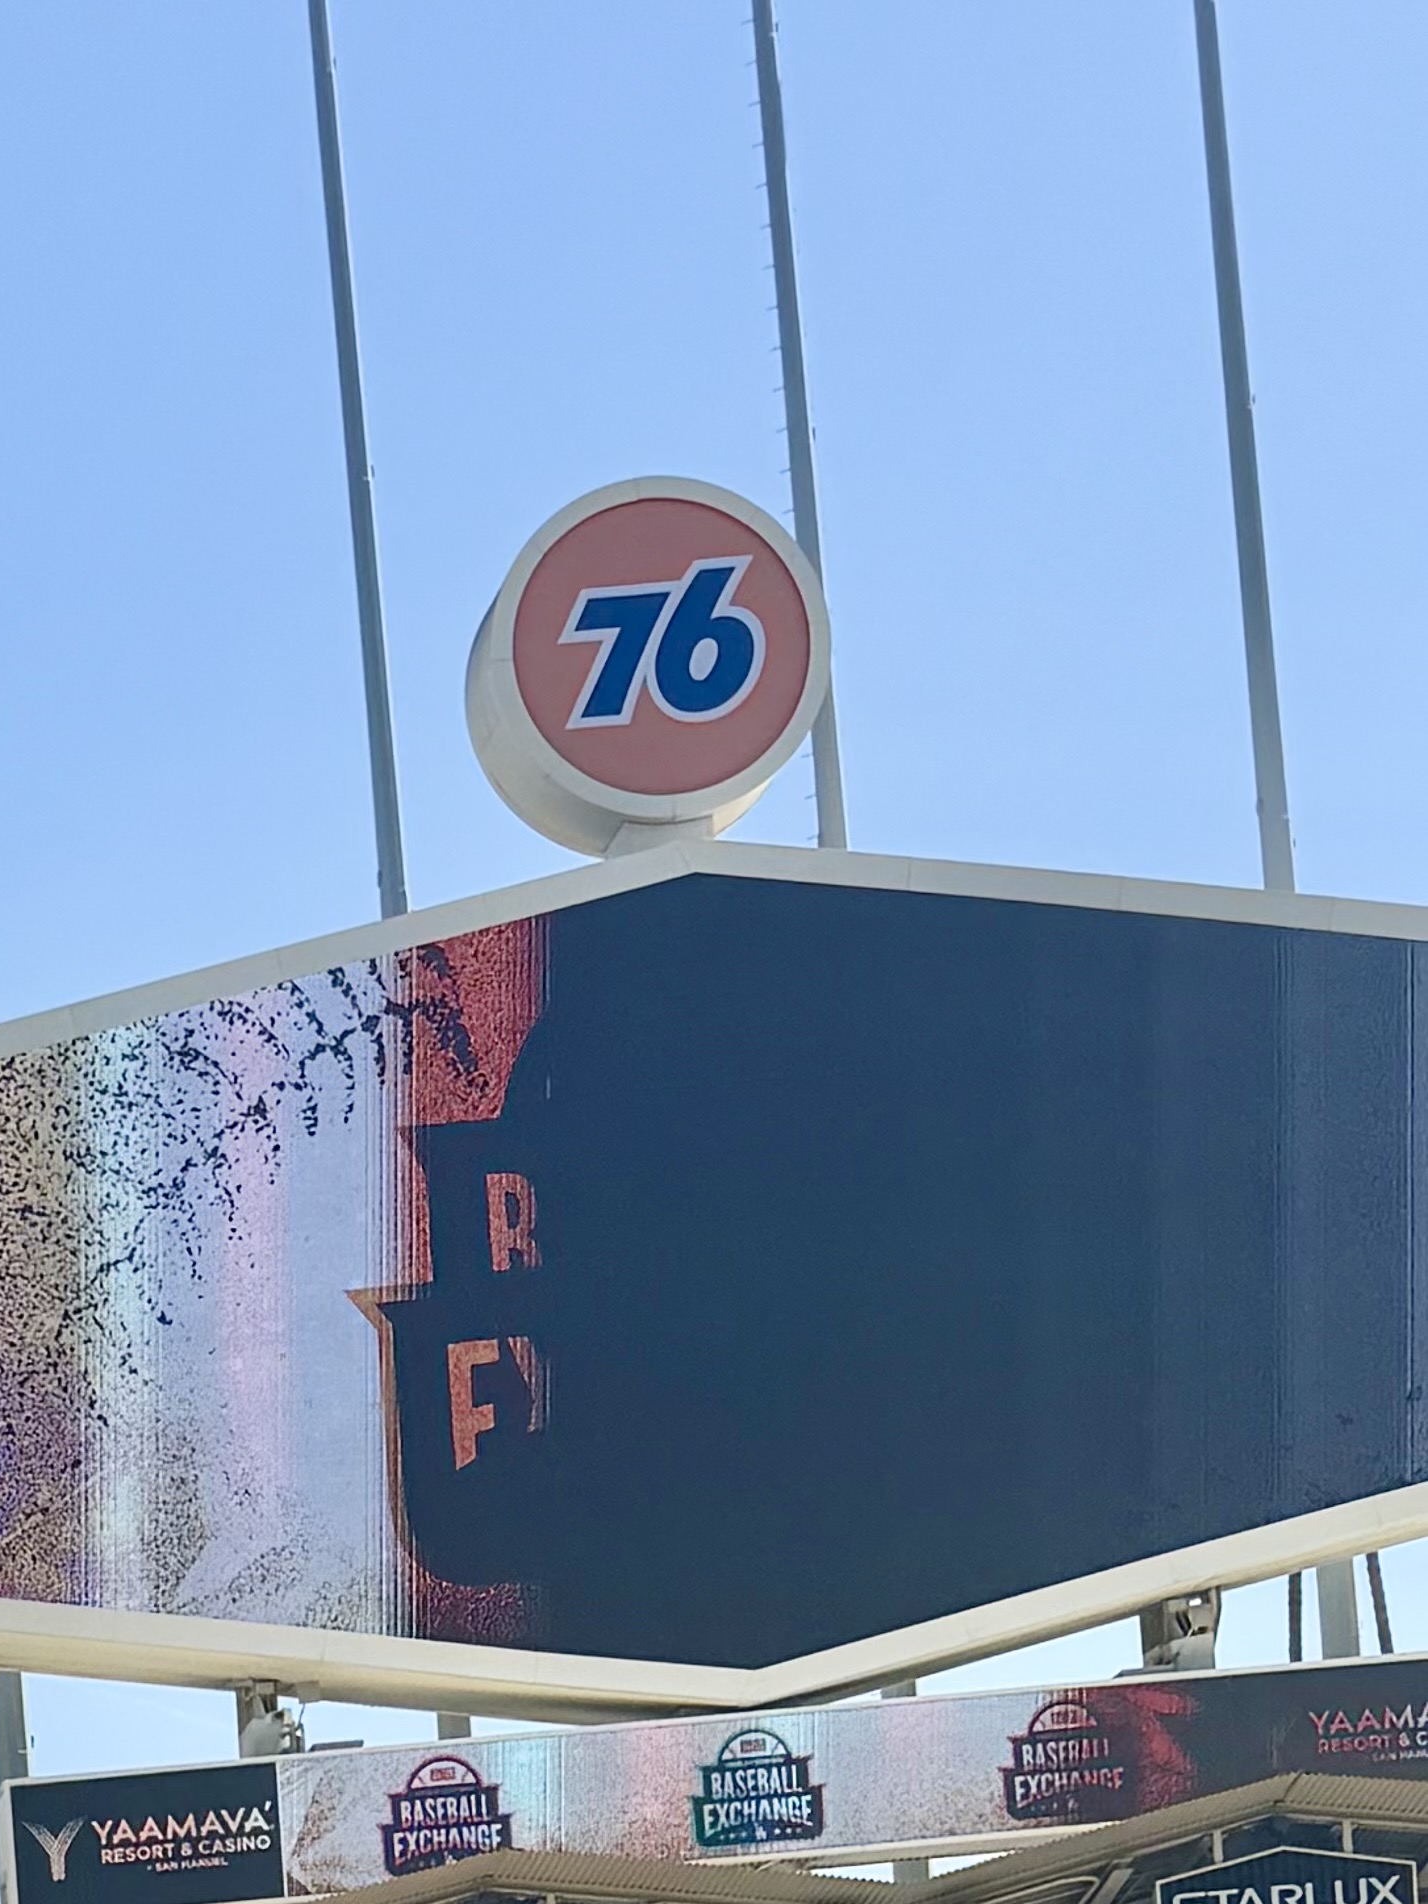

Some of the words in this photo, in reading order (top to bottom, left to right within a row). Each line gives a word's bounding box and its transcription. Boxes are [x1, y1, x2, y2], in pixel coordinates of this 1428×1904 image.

[558, 555, 762, 730] 76
[1022, 1738, 1109, 1771] BASEBALL
[711, 1765, 802, 1799] BASEBALL
[400, 1794, 491, 1827] BASEBALL
[703, 1795, 813, 1838] EXCHANGE
[101, 1843, 175, 1864] RESORT
[180, 1842, 193, 1856] &
[198, 1835, 271, 1854] CASINO
[393, 1824, 502, 1866] EXCHANGE
